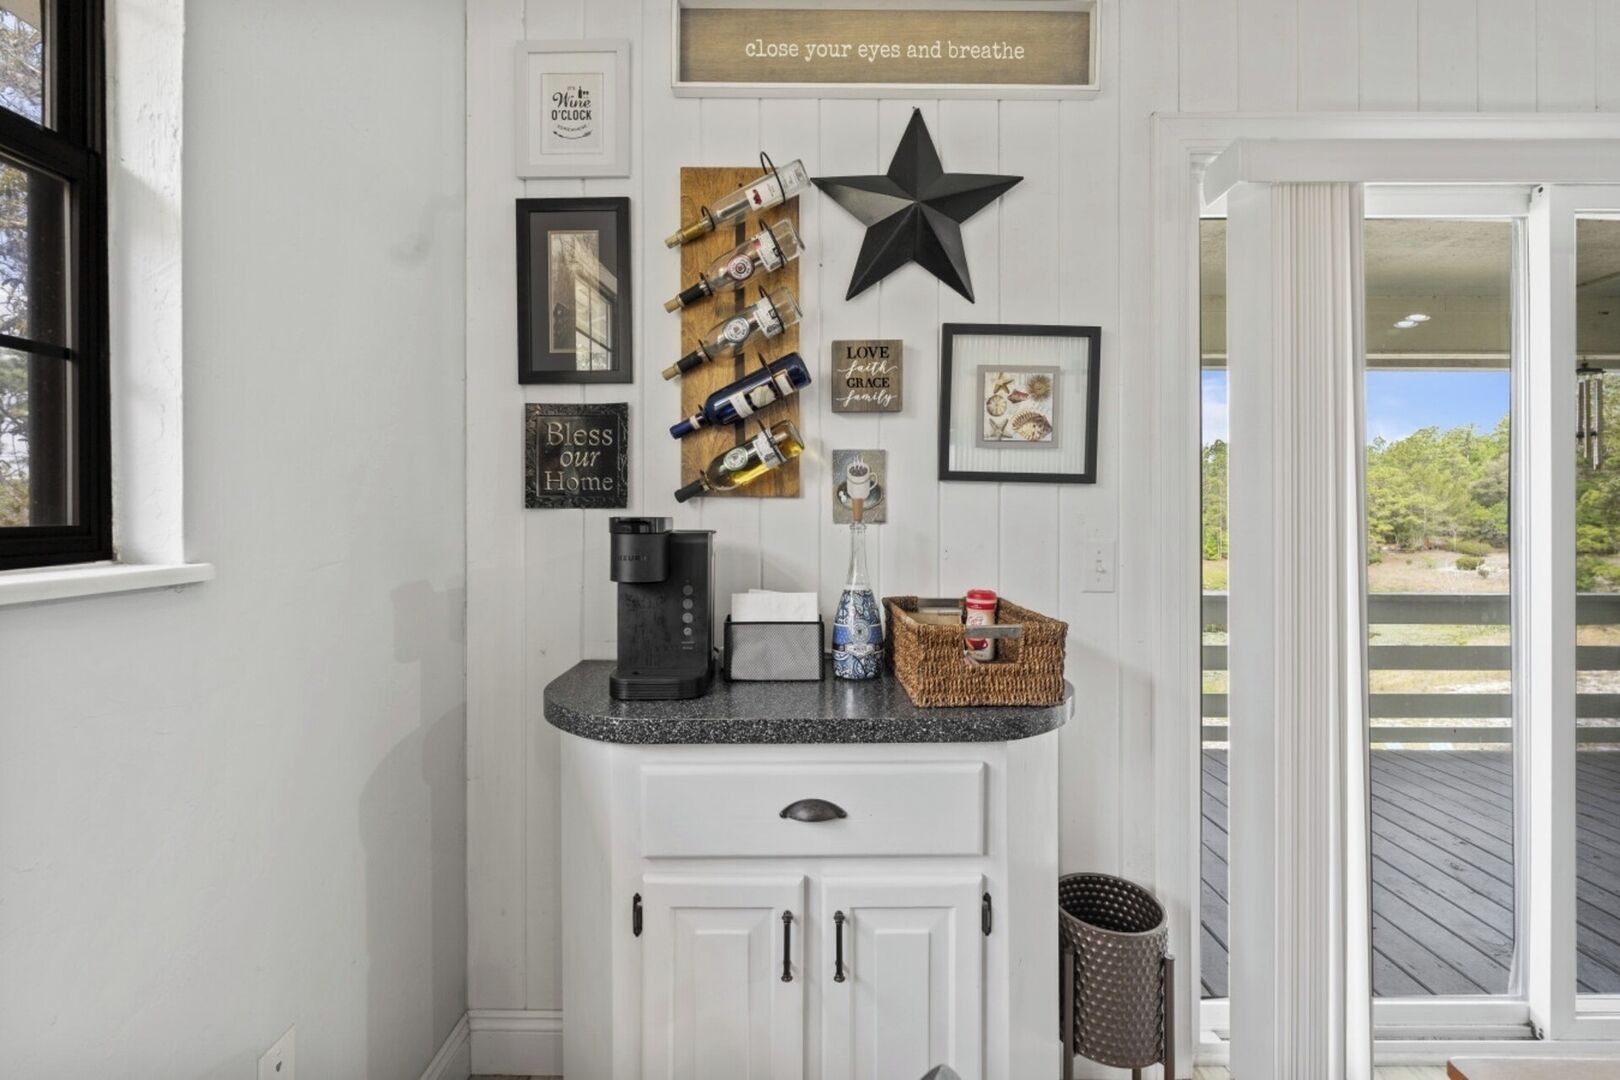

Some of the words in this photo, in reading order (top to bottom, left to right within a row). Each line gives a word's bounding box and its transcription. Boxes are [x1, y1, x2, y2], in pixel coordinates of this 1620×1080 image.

[745, 39, 799, 57] close
[804, 43, 852, 62] your
[858, 43, 900, 62] eyes
[906, 40, 942, 58] and
[947, 40, 1025, 59] breathe
[552, 91, 591, 108] Wine
[551, 109, 592, 121] O'CLOCK
[846, 346, 890, 359] LOVE
[837, 360, 898, 379] faith
[846, 377, 890, 389] GRACE
[836, 389, 897, 407] family
[546, 421, 613, 446] Bless
[560, 451, 601, 467] our
[544, 471, 613, 491] Home
